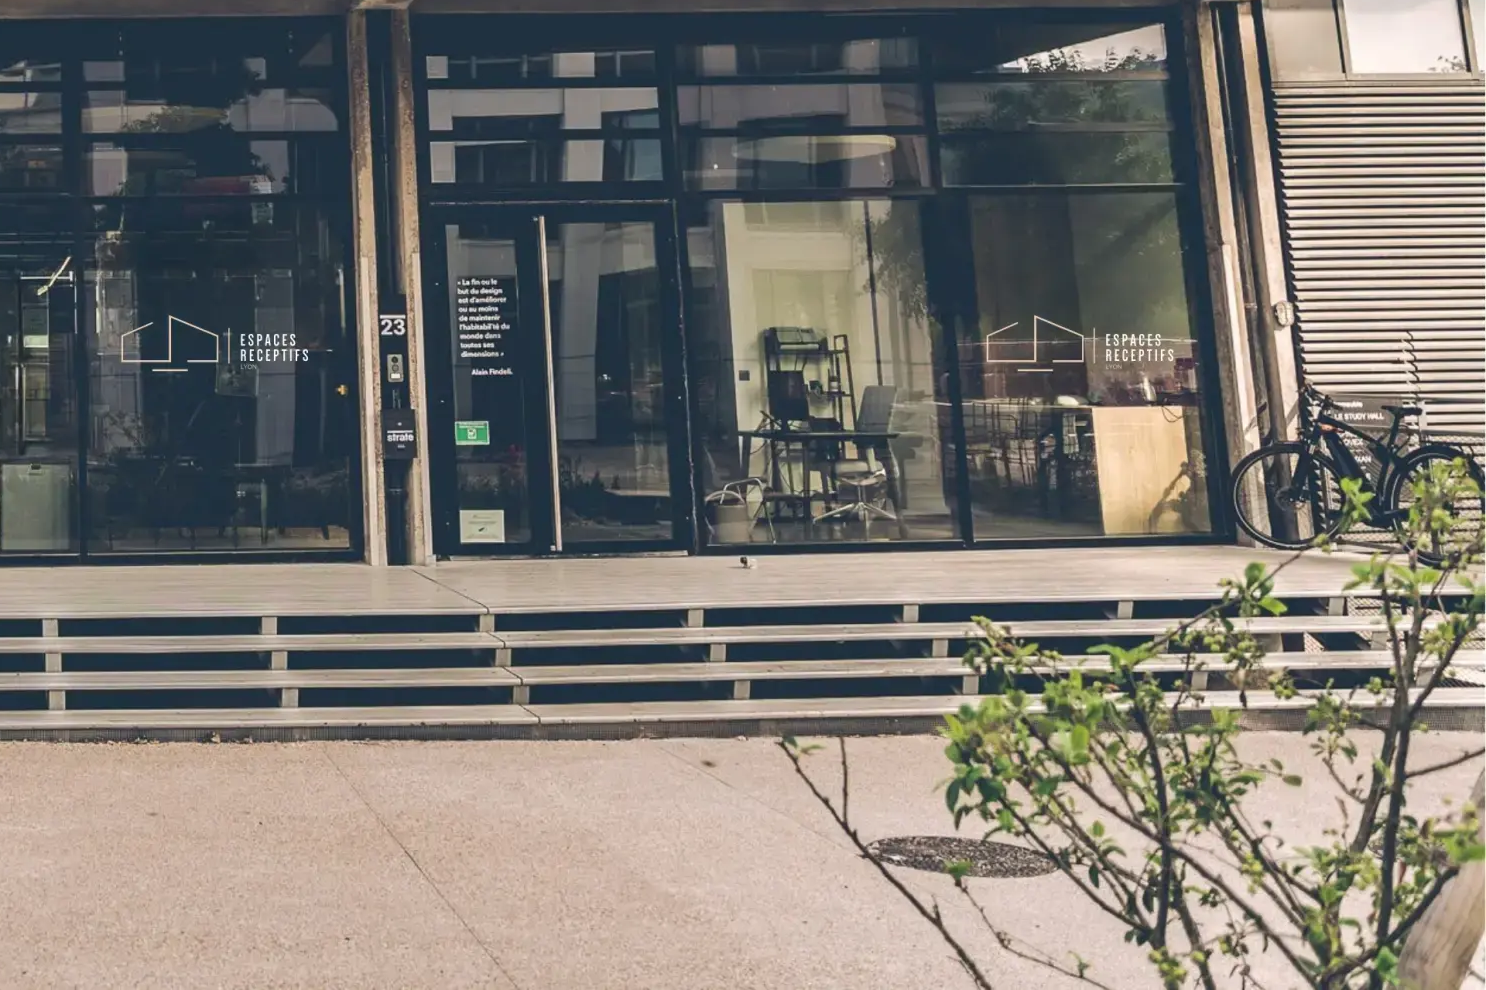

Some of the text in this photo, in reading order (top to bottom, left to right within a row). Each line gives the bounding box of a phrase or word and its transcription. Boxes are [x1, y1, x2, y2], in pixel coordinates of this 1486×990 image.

[381, 319, 406, 335] 23
[240, 333, 296, 346] ESPACES
[1105, 333, 1162, 347] ESPACES
[240, 349, 309, 362] RECEPTIFS
[1105, 349, 1174, 362] RECEPTIFS
[387, 433, 414, 442] strate
